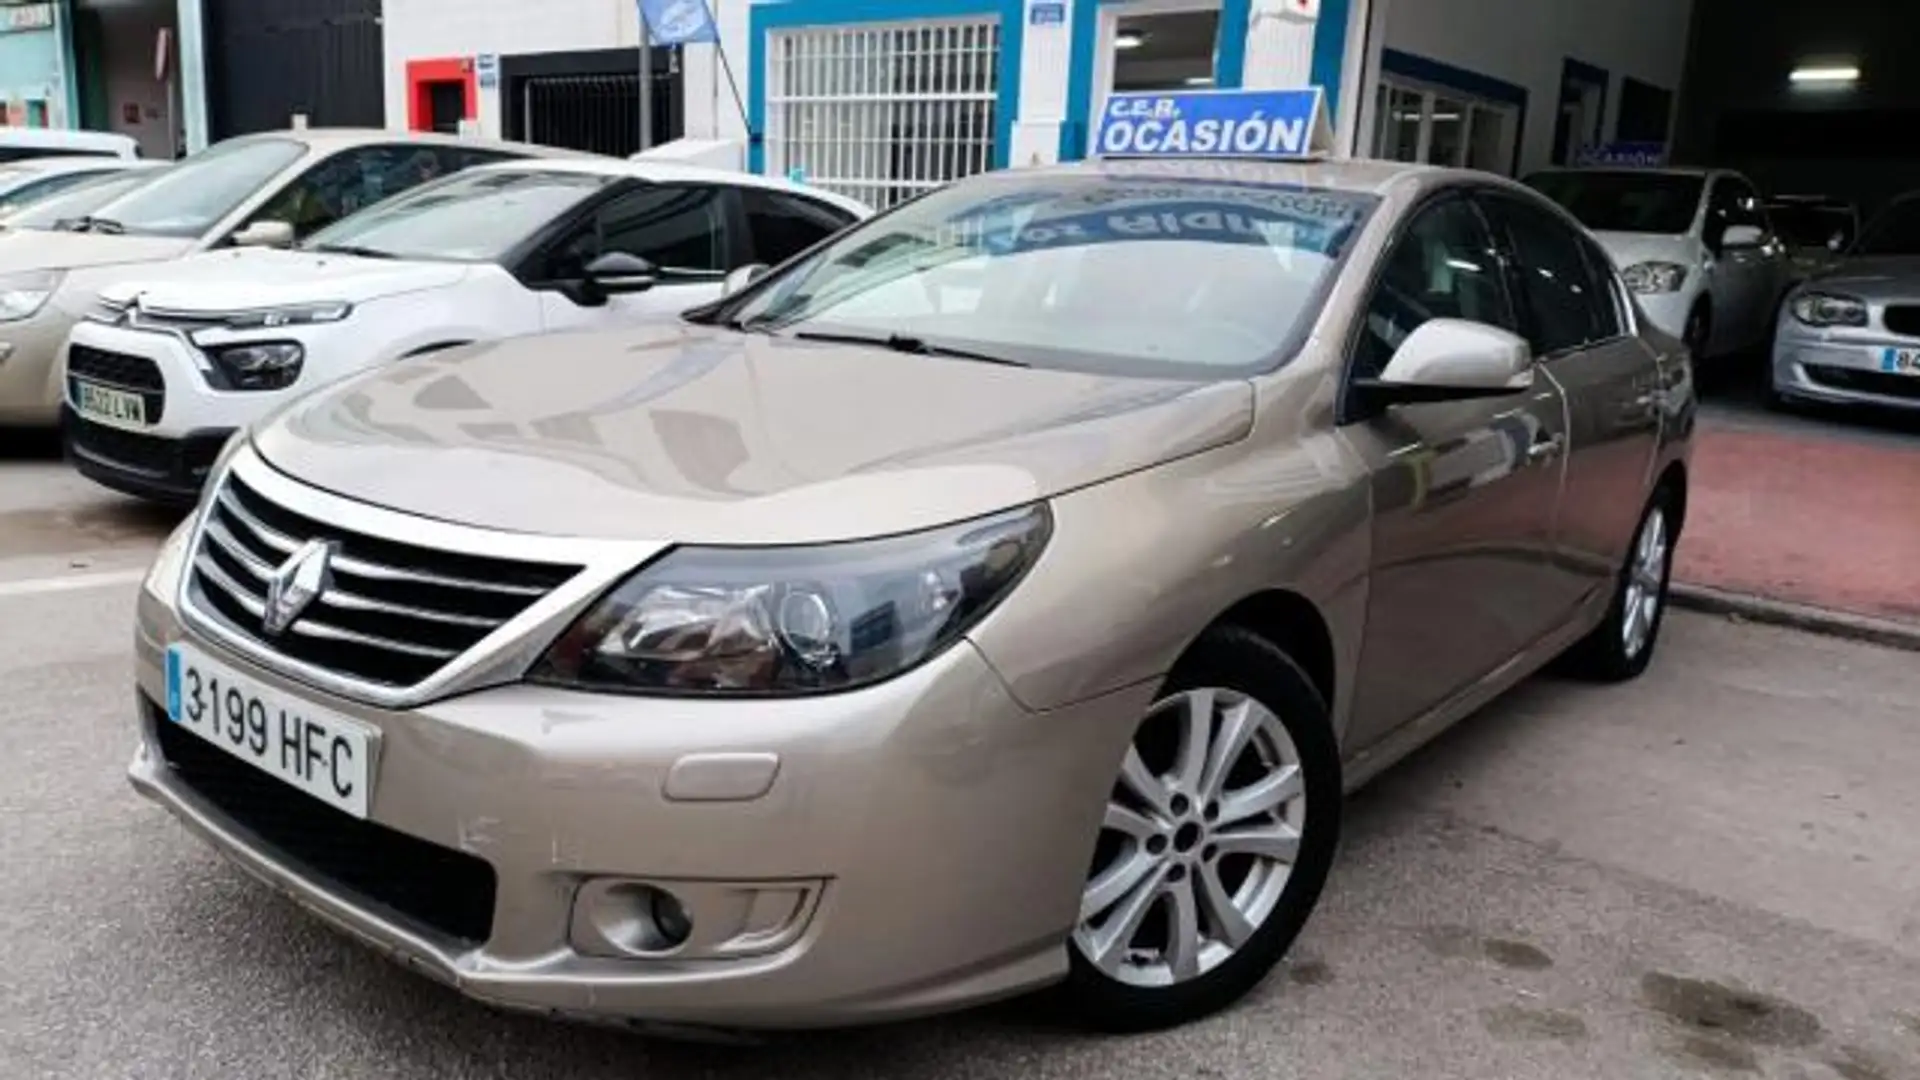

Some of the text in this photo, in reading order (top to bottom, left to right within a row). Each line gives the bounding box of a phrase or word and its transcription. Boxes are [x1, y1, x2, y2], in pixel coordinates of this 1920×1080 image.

[1103, 110, 1304, 152] OCASIÓN
[186, 666, 353, 799] 3199 HFC
